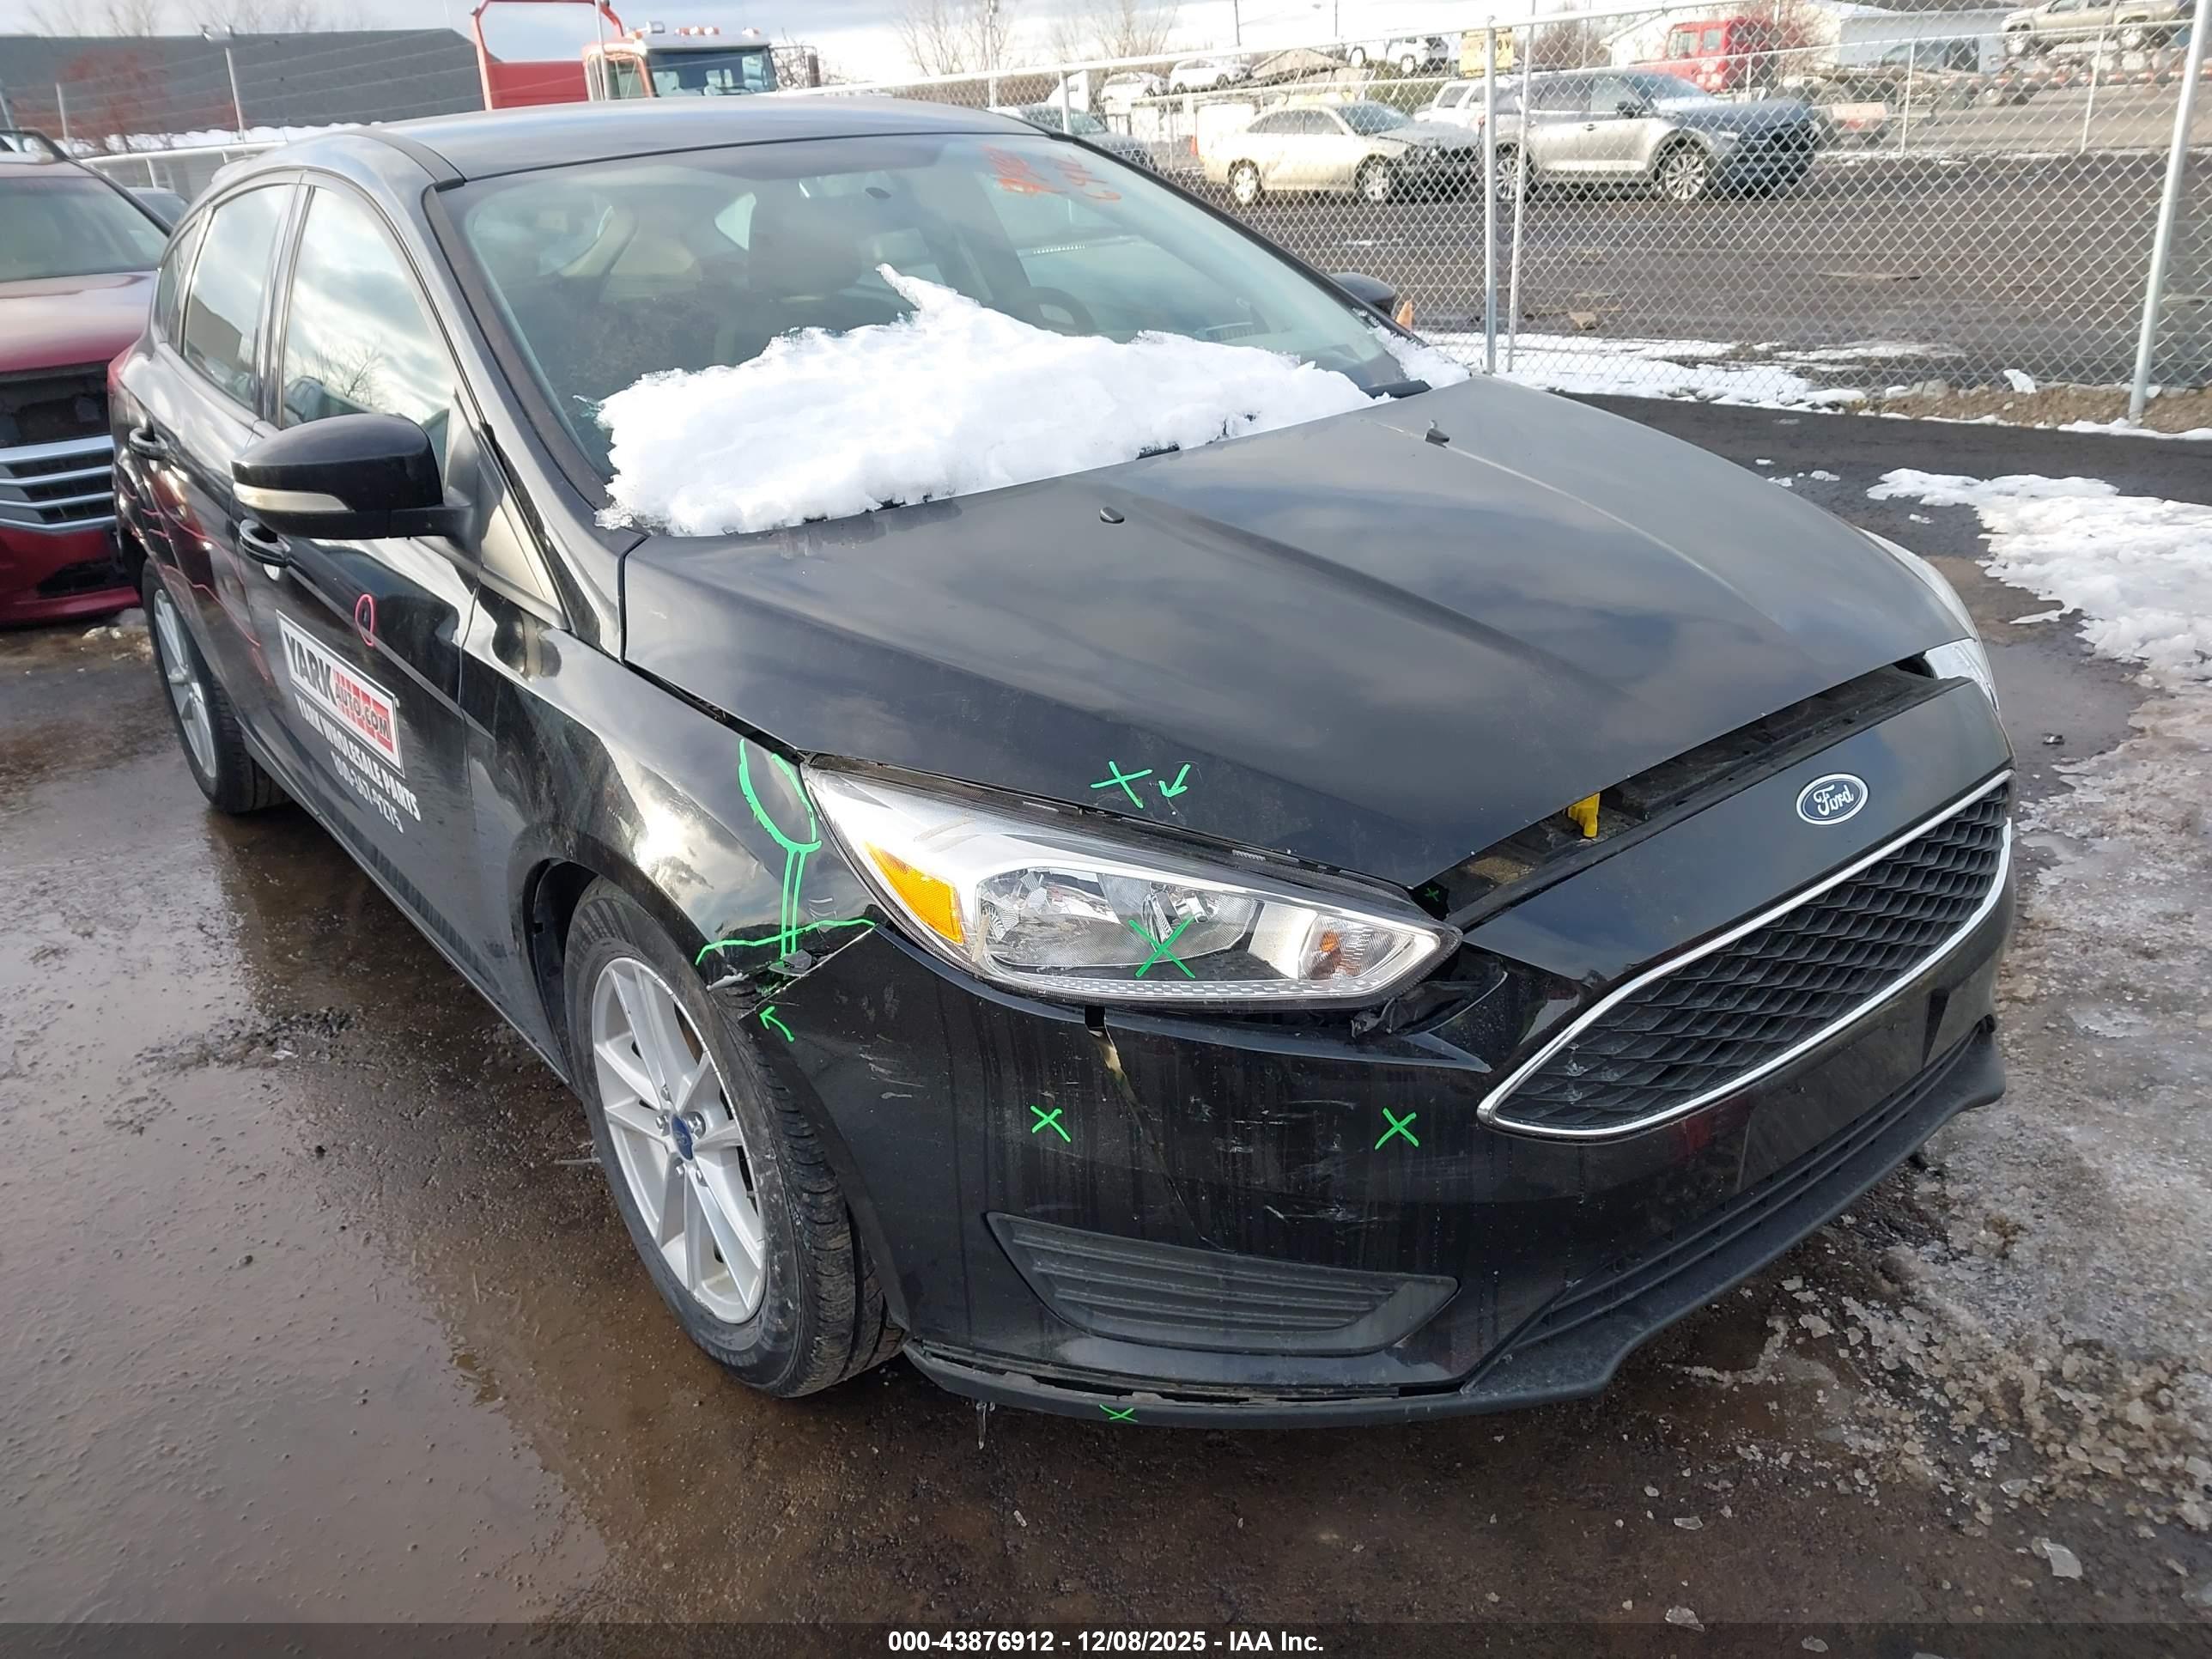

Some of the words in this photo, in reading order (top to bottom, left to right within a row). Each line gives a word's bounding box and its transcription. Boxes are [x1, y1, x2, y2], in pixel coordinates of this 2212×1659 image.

[283, 629, 337, 708] YARK
[335, 682, 391, 741] AUTO.COM
[295, 692, 325, 737] YARK
[325, 724, 384, 790] WHOLESALE
[381, 774, 422, 822] PARTS
[1813, 784, 1855, 816] Ford
